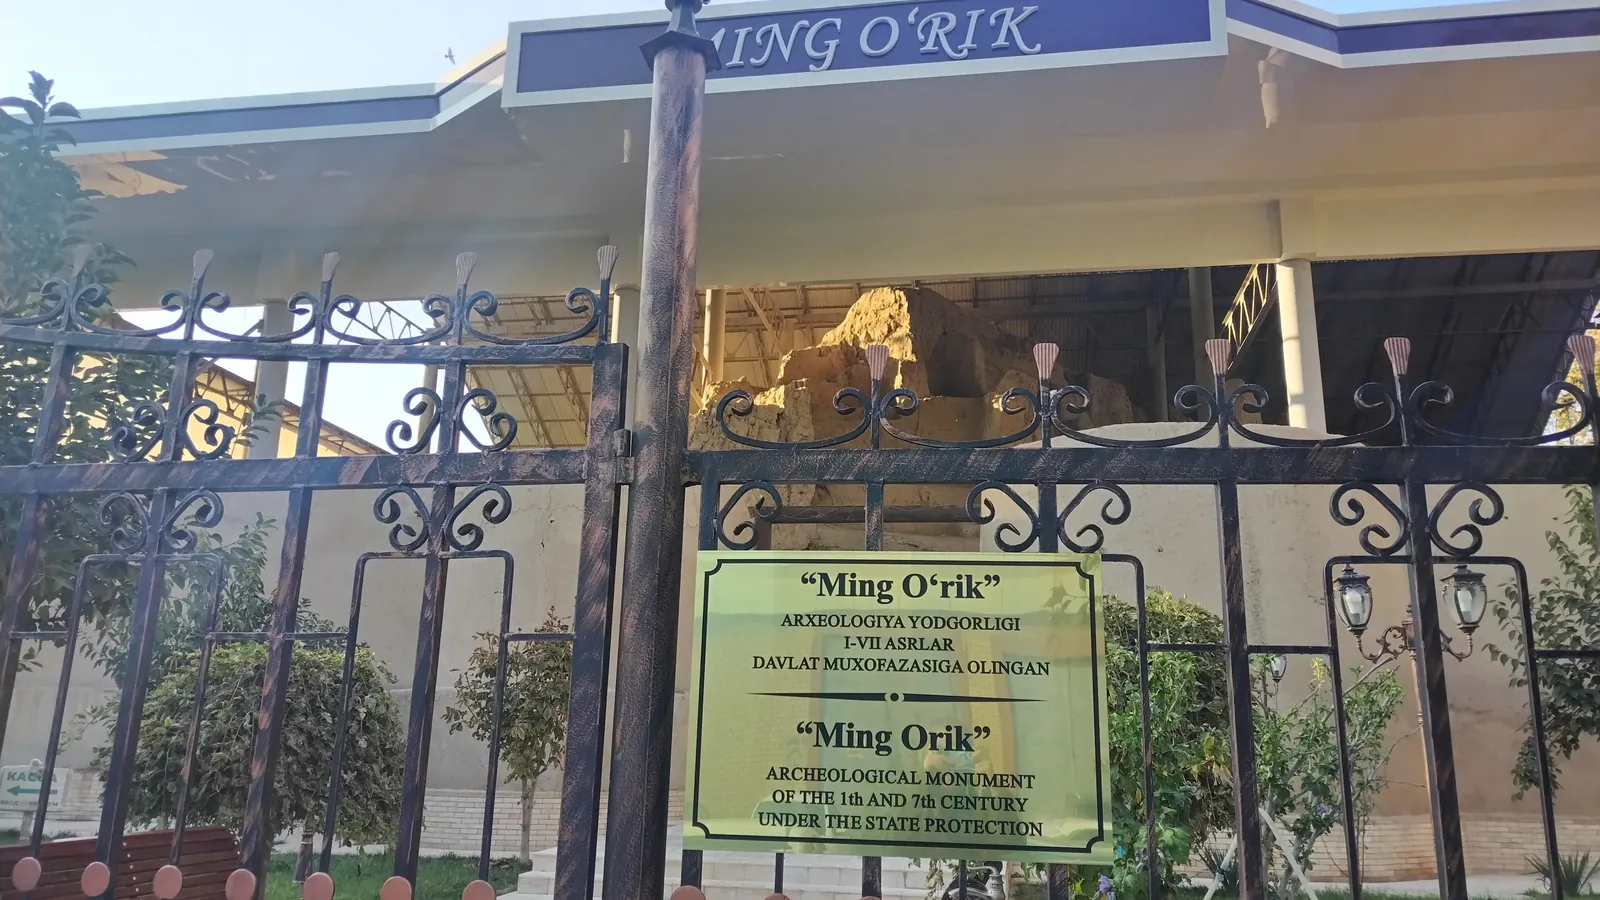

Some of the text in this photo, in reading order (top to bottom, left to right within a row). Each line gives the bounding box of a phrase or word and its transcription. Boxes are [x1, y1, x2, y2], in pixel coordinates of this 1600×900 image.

[780, 613, 1021, 632] ARXEOLOGIYA YODGORLIGI
[843, 636, 955, 652] I-VII ASRLAR
[752, 655, 1051, 677] DAVLAT MUXOFAZASIGA OLINGAN
[765, 766, 1036, 790] ARCHEOLOGICAL MONUMENT
[771, 788, 1029, 813] OF THE 1th AND 7th CENTURY
[757, 811, 1044, 838] UNDER THE STATE PROTECTION
